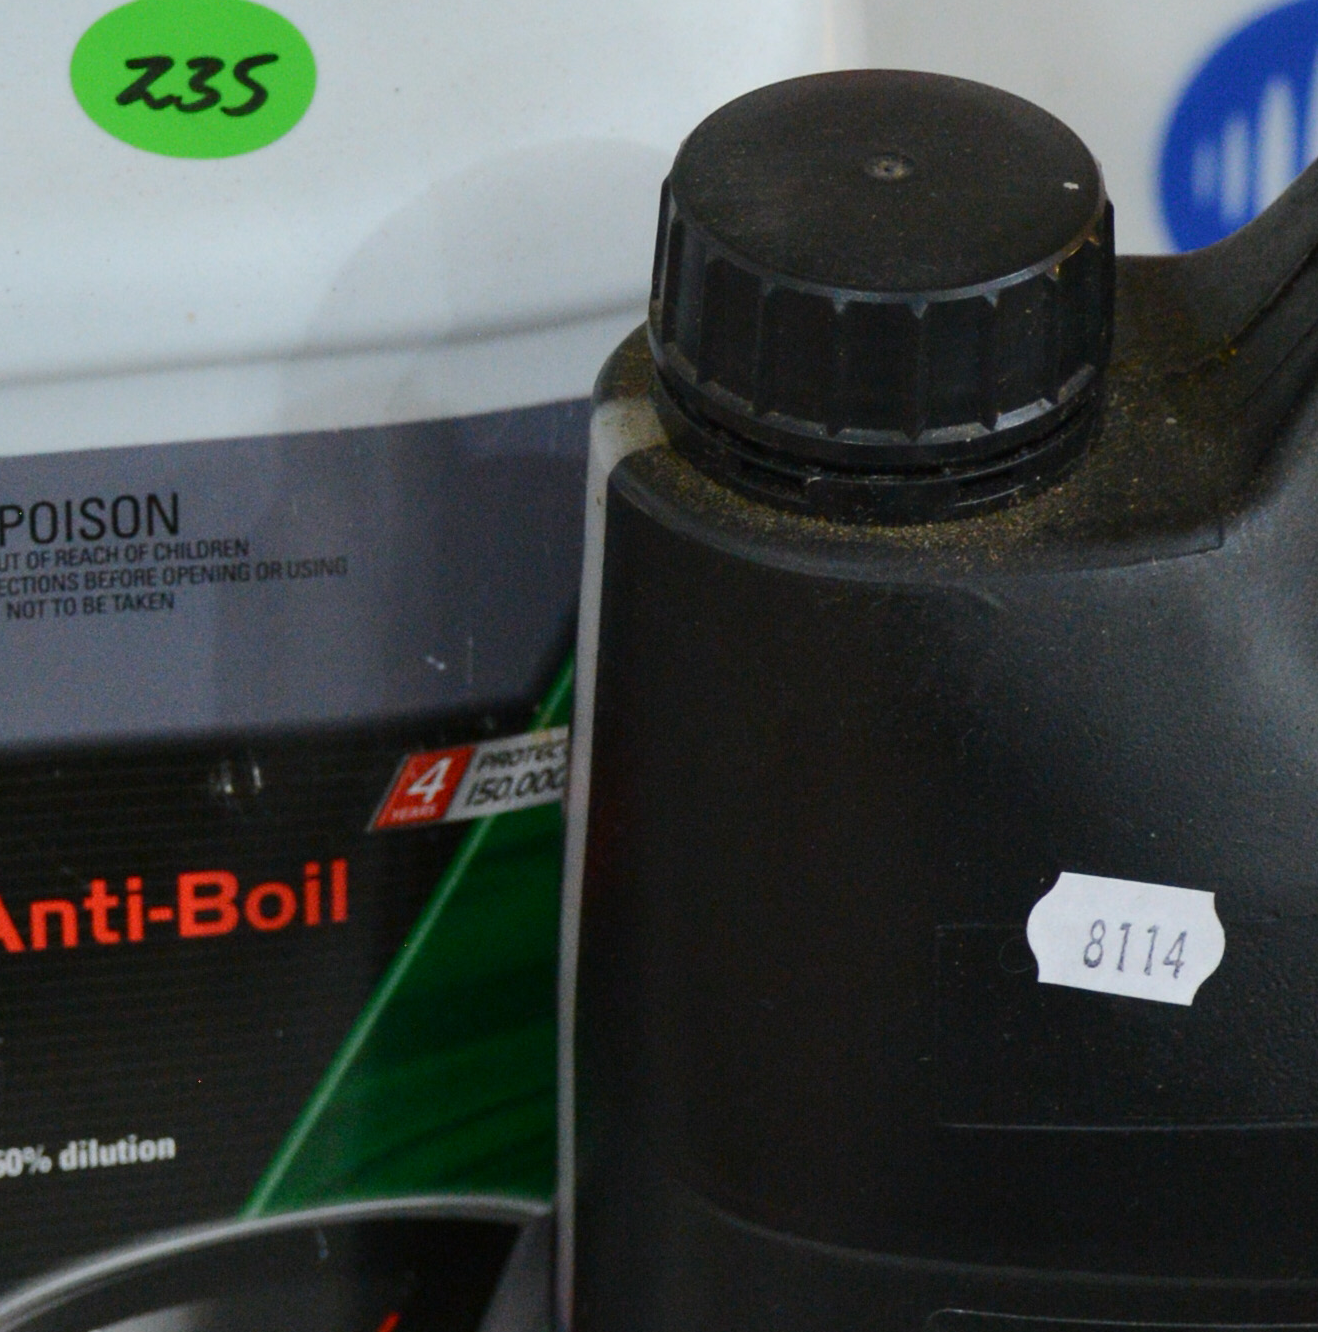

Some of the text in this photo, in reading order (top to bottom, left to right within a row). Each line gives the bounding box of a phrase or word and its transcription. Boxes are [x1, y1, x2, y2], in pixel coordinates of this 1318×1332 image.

[115, 52, 280, 118] 235
[26, 549, 54, 570] OF
[54, 544, 119, 567] REACH
[124, 543, 148, 564] OF
[153, 537, 250, 562] CHILDREN
[85, 567, 156, 591] BEFORE
[162, 563, 250, 587] OPENING
[254, 561, 283, 581] OR
[286, 556, 349, 579] USING
[6, 591, 175, 620] NOT TO BE TAKEN
[406, 756, 453, 804] 4
[1083, 918, 1188, 980] 8114
[58, 1133, 177, 1172] dilution
